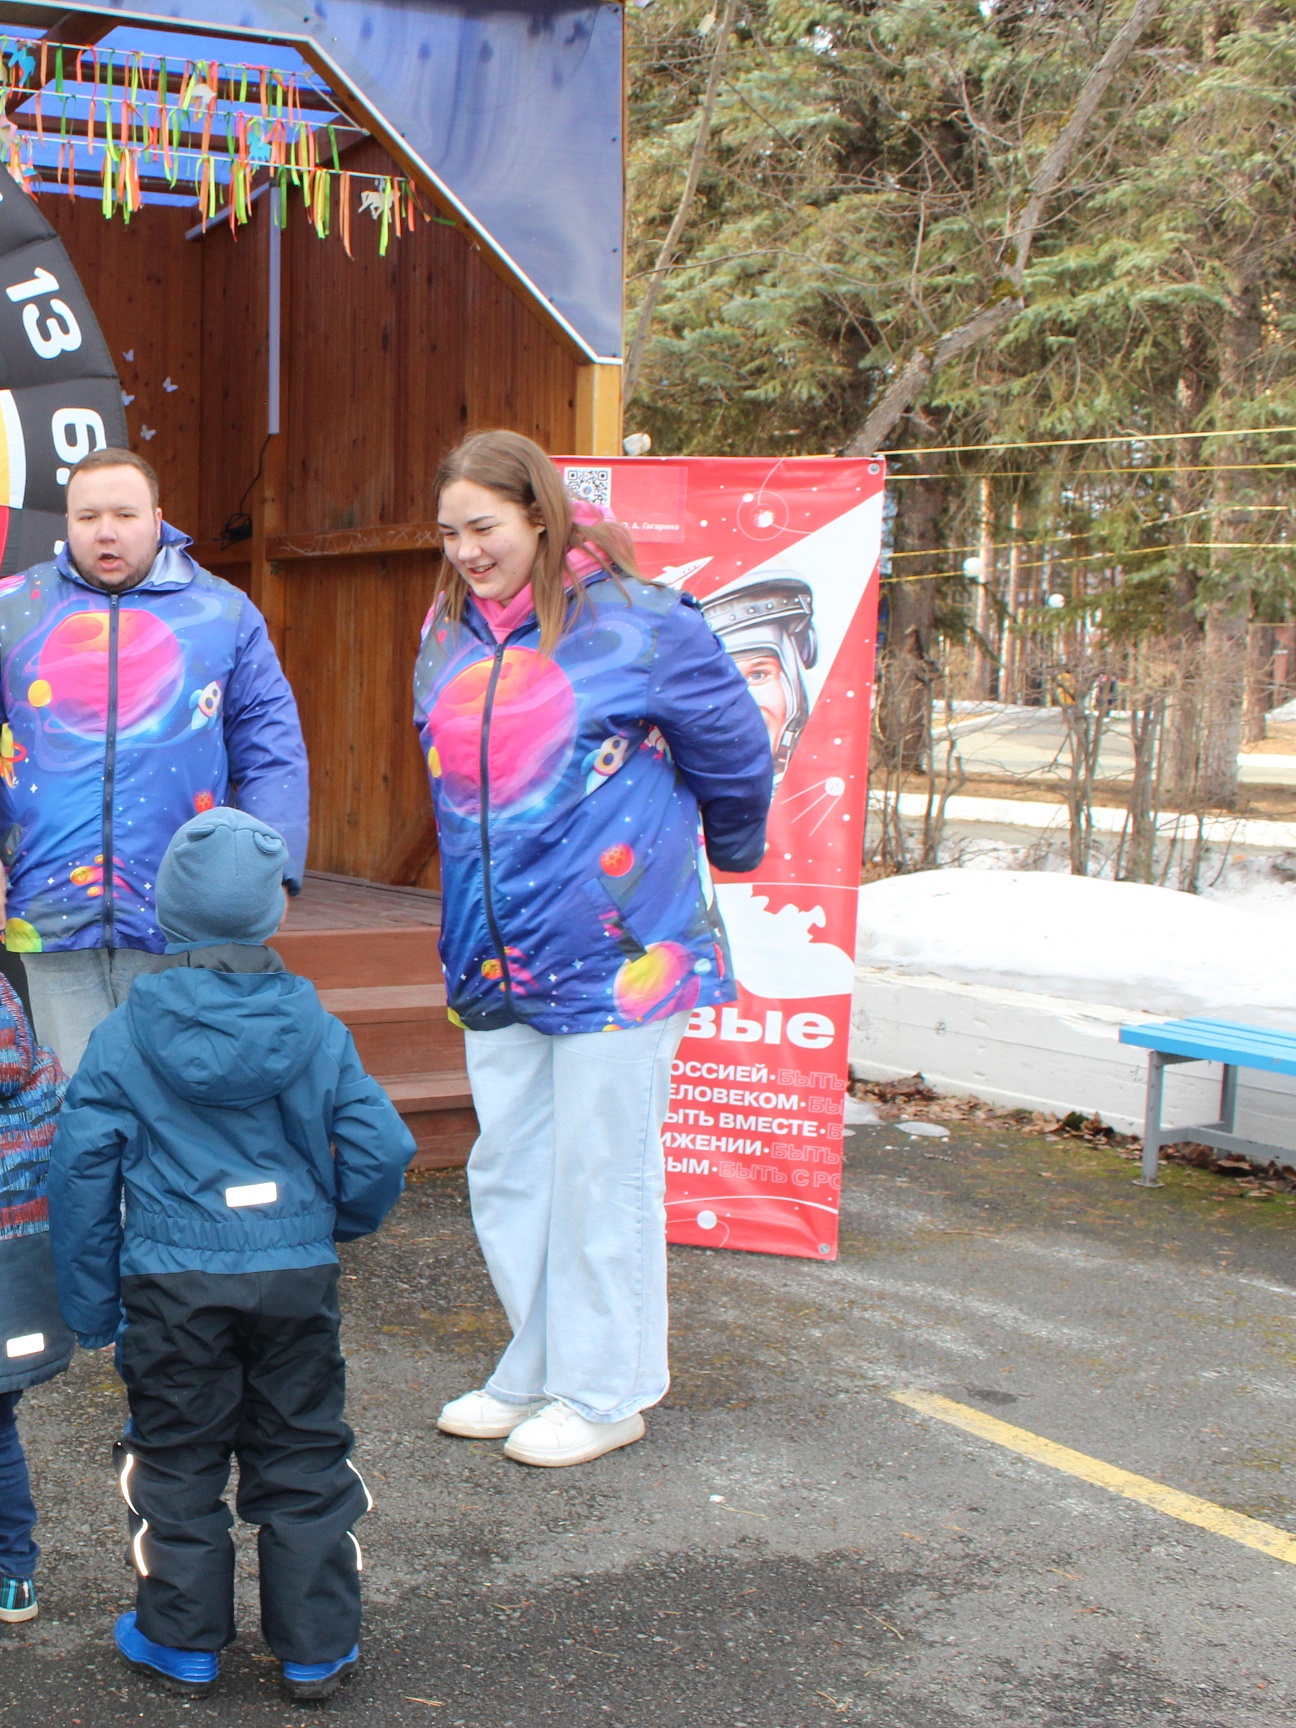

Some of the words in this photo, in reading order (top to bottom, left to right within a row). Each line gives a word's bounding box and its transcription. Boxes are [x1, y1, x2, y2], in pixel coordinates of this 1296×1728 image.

[6, 267, 82, 360] 13
[642, 521, 680, 531] Гагарина
[777, 1068, 847, 1091] БЫТЬ
[719, 1112, 819, 1138] ВМЕСТЕ
[771, 1142, 841, 1165] БЫТЬ
[663, 1156, 710, 1176] ЫМ
[719, 1160, 788, 1184] БЫТЬ
[791, 1168, 810, 1187] С
